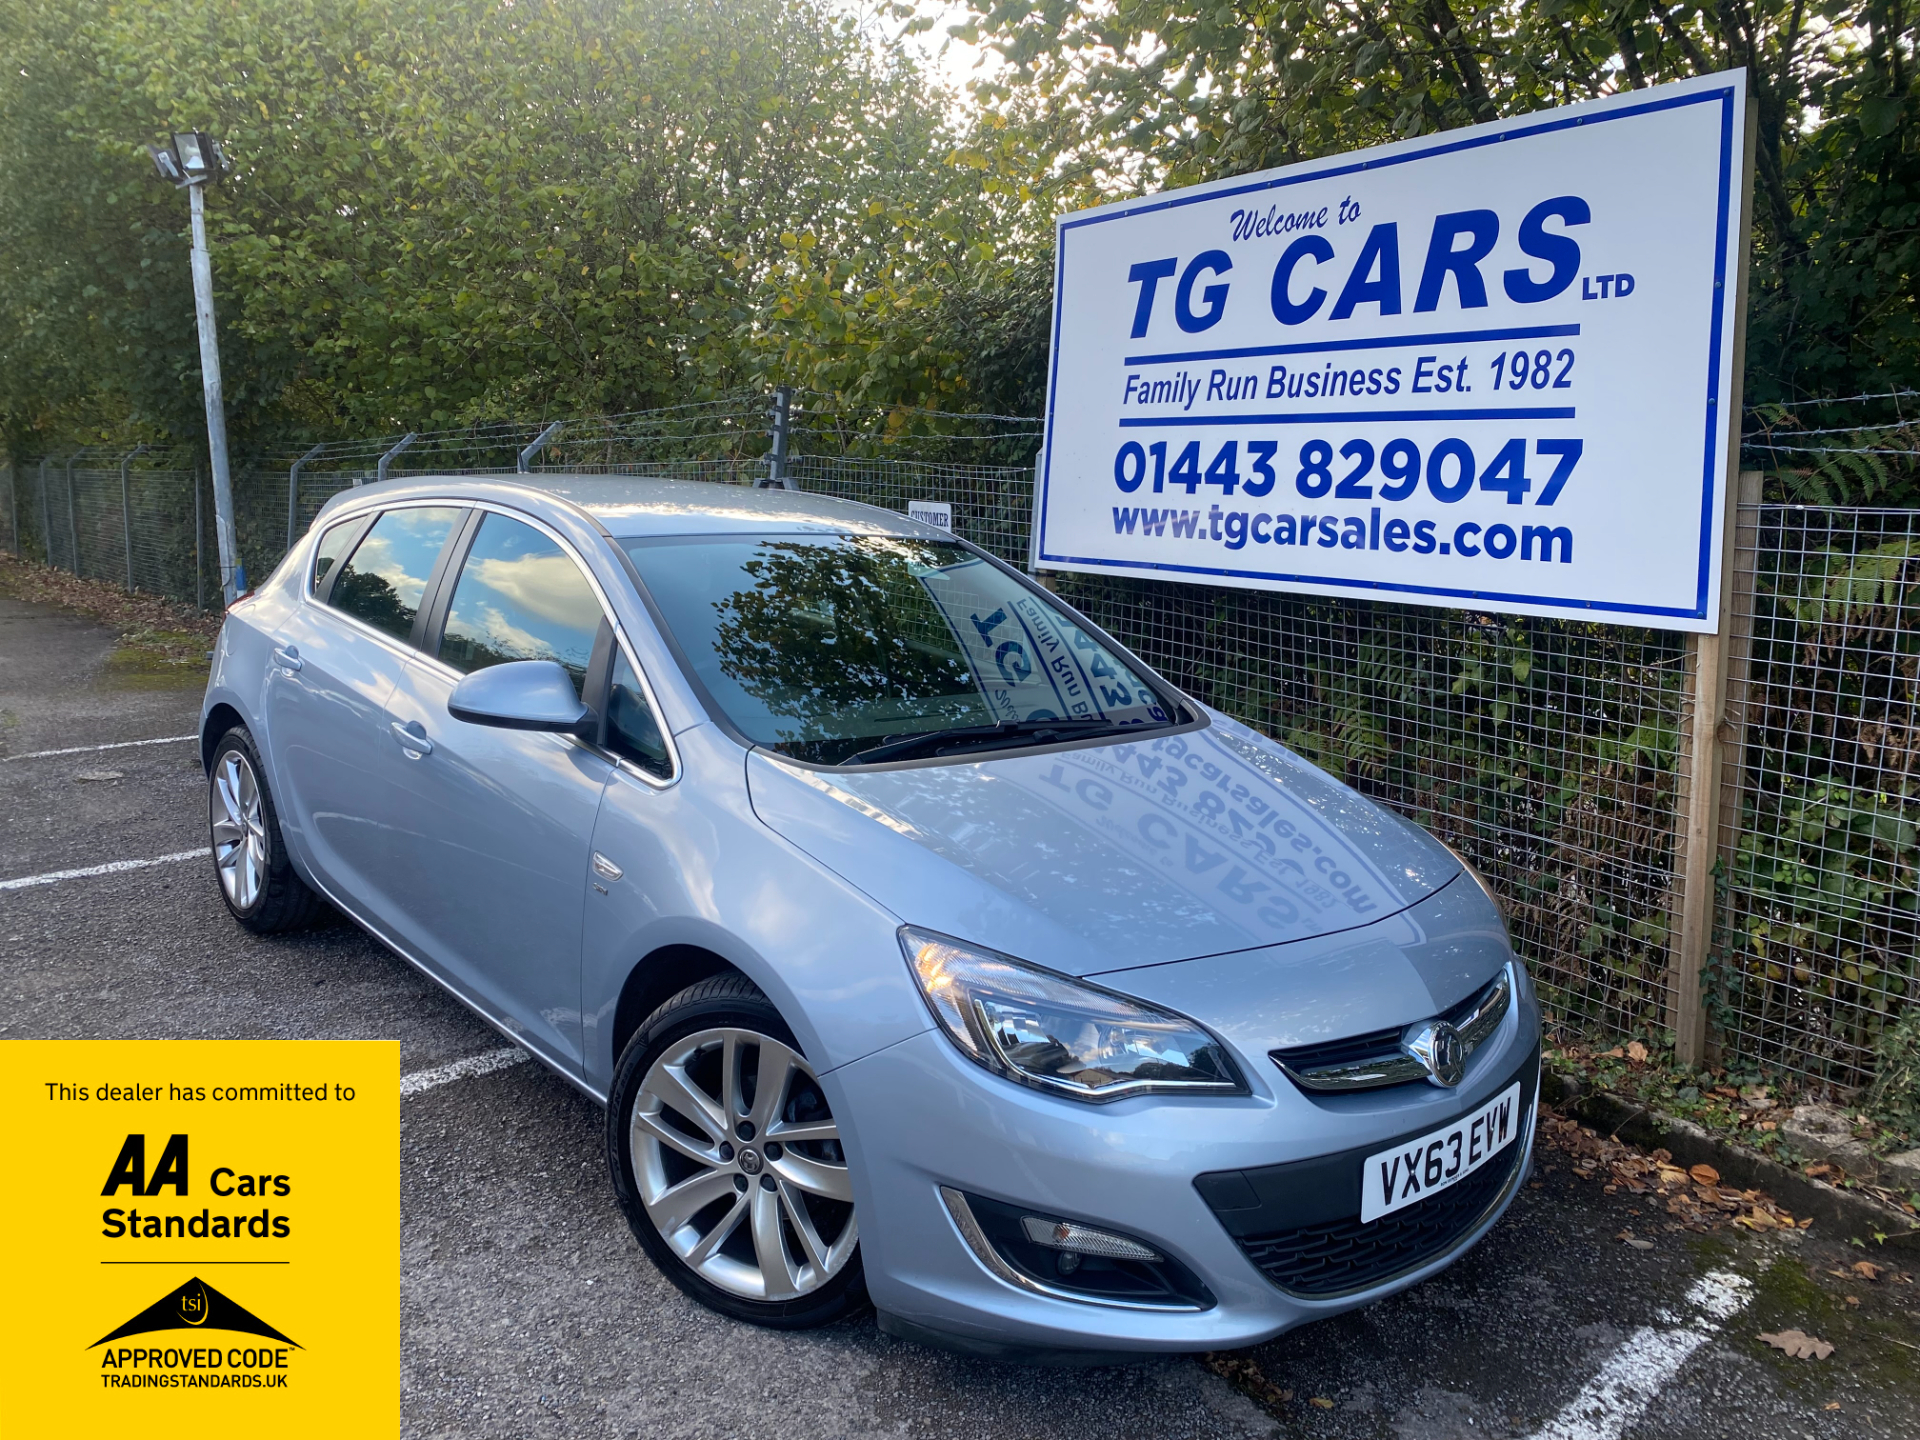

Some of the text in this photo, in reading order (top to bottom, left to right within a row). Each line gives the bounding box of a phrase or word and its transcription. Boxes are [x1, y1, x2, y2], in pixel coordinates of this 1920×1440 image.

[1229, 195, 1362, 242] Welcome to
[1126, 195, 1636, 340] TG CARS LTD
[1122, 348, 1576, 411] Family Run Business Est. 1982
[1113, 437, 1584, 507] 01443 829047
[1112, 504, 1573, 564] www.tgcarsales.com
[1380, 1096, 1512, 1206] VX63 EVW
